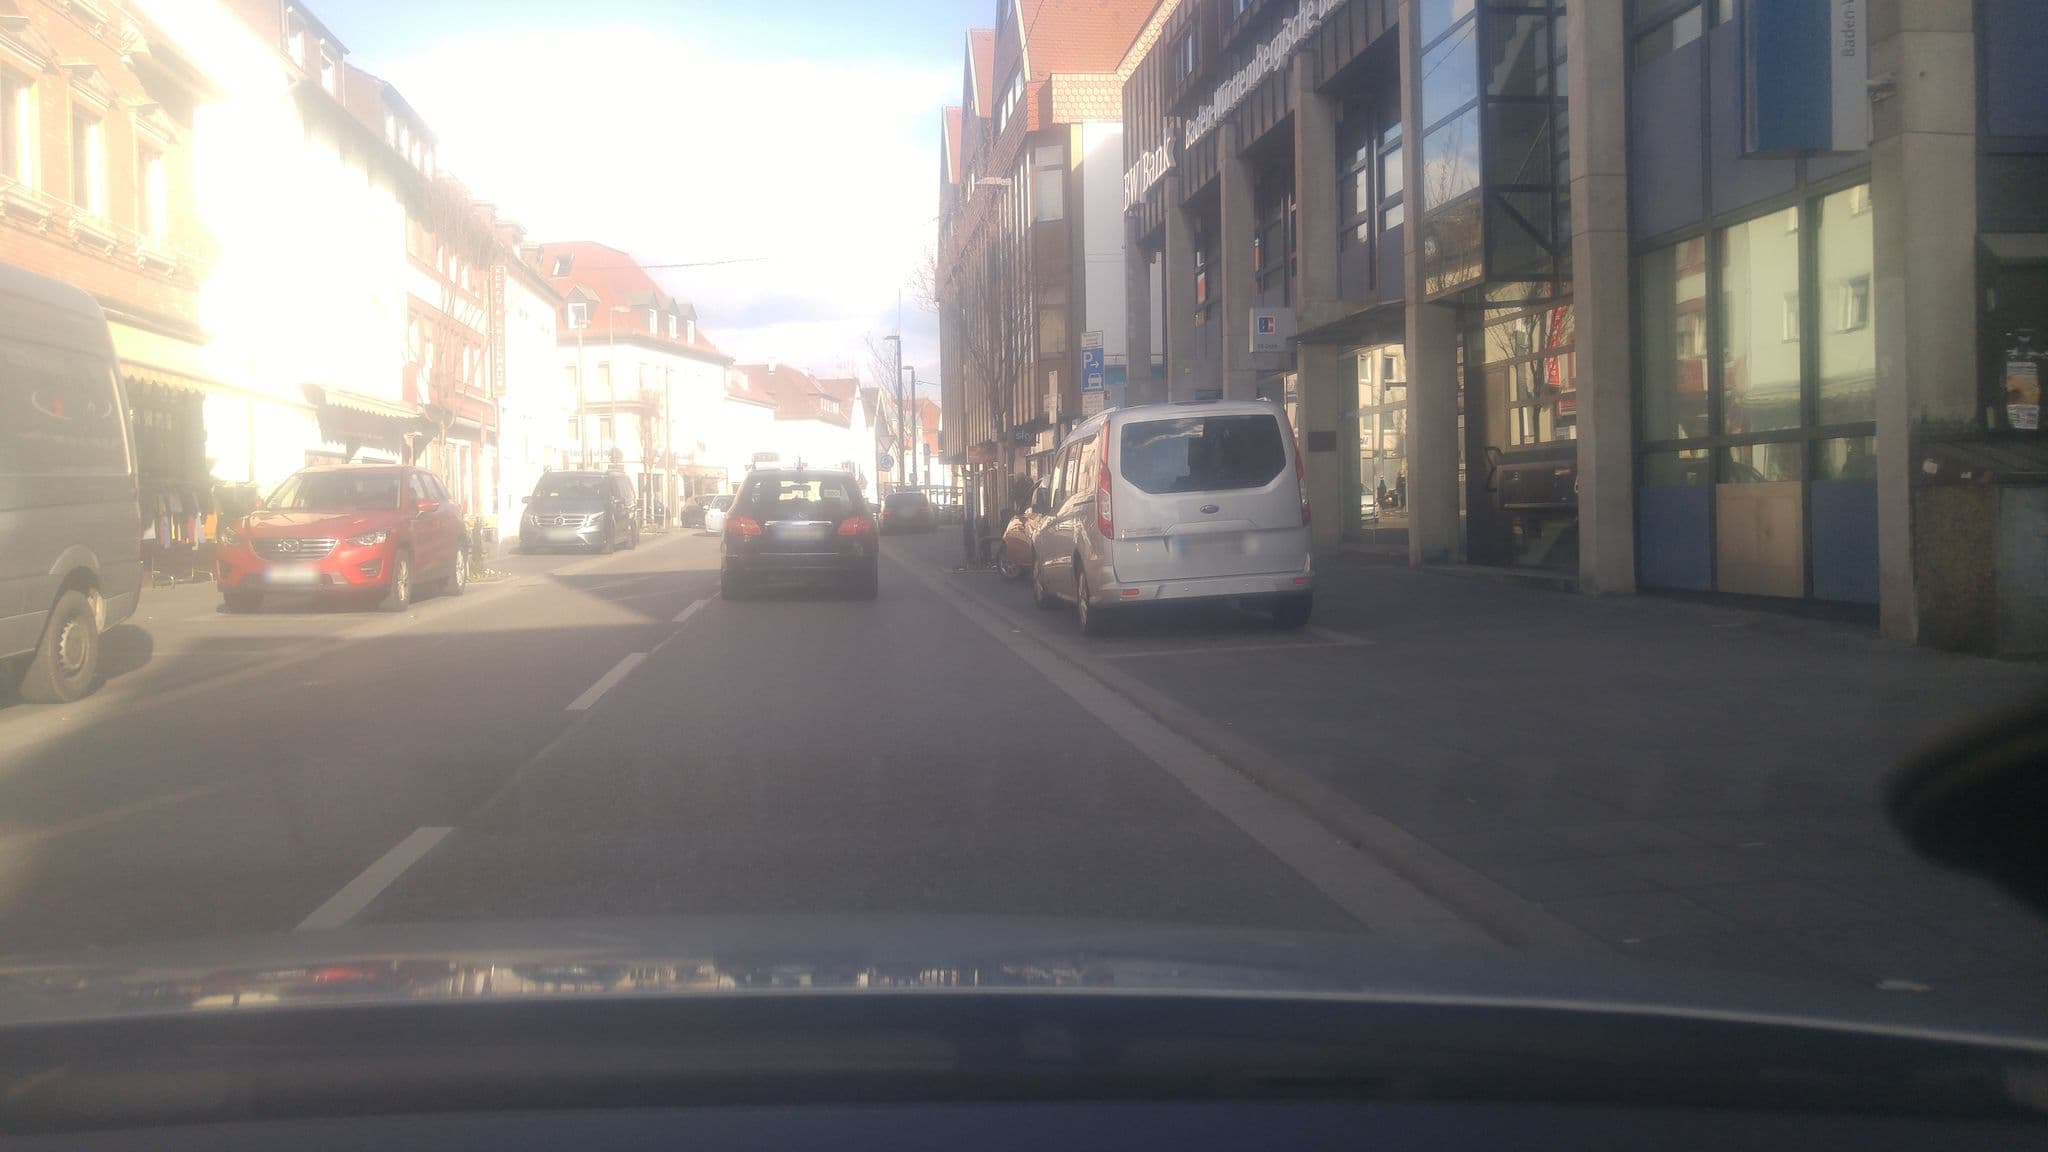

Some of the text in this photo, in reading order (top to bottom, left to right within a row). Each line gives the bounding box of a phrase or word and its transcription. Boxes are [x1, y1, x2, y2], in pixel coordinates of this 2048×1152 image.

[1123, 127, 1174, 212] BW Bank
[1083, 351, 1093, 369] P
